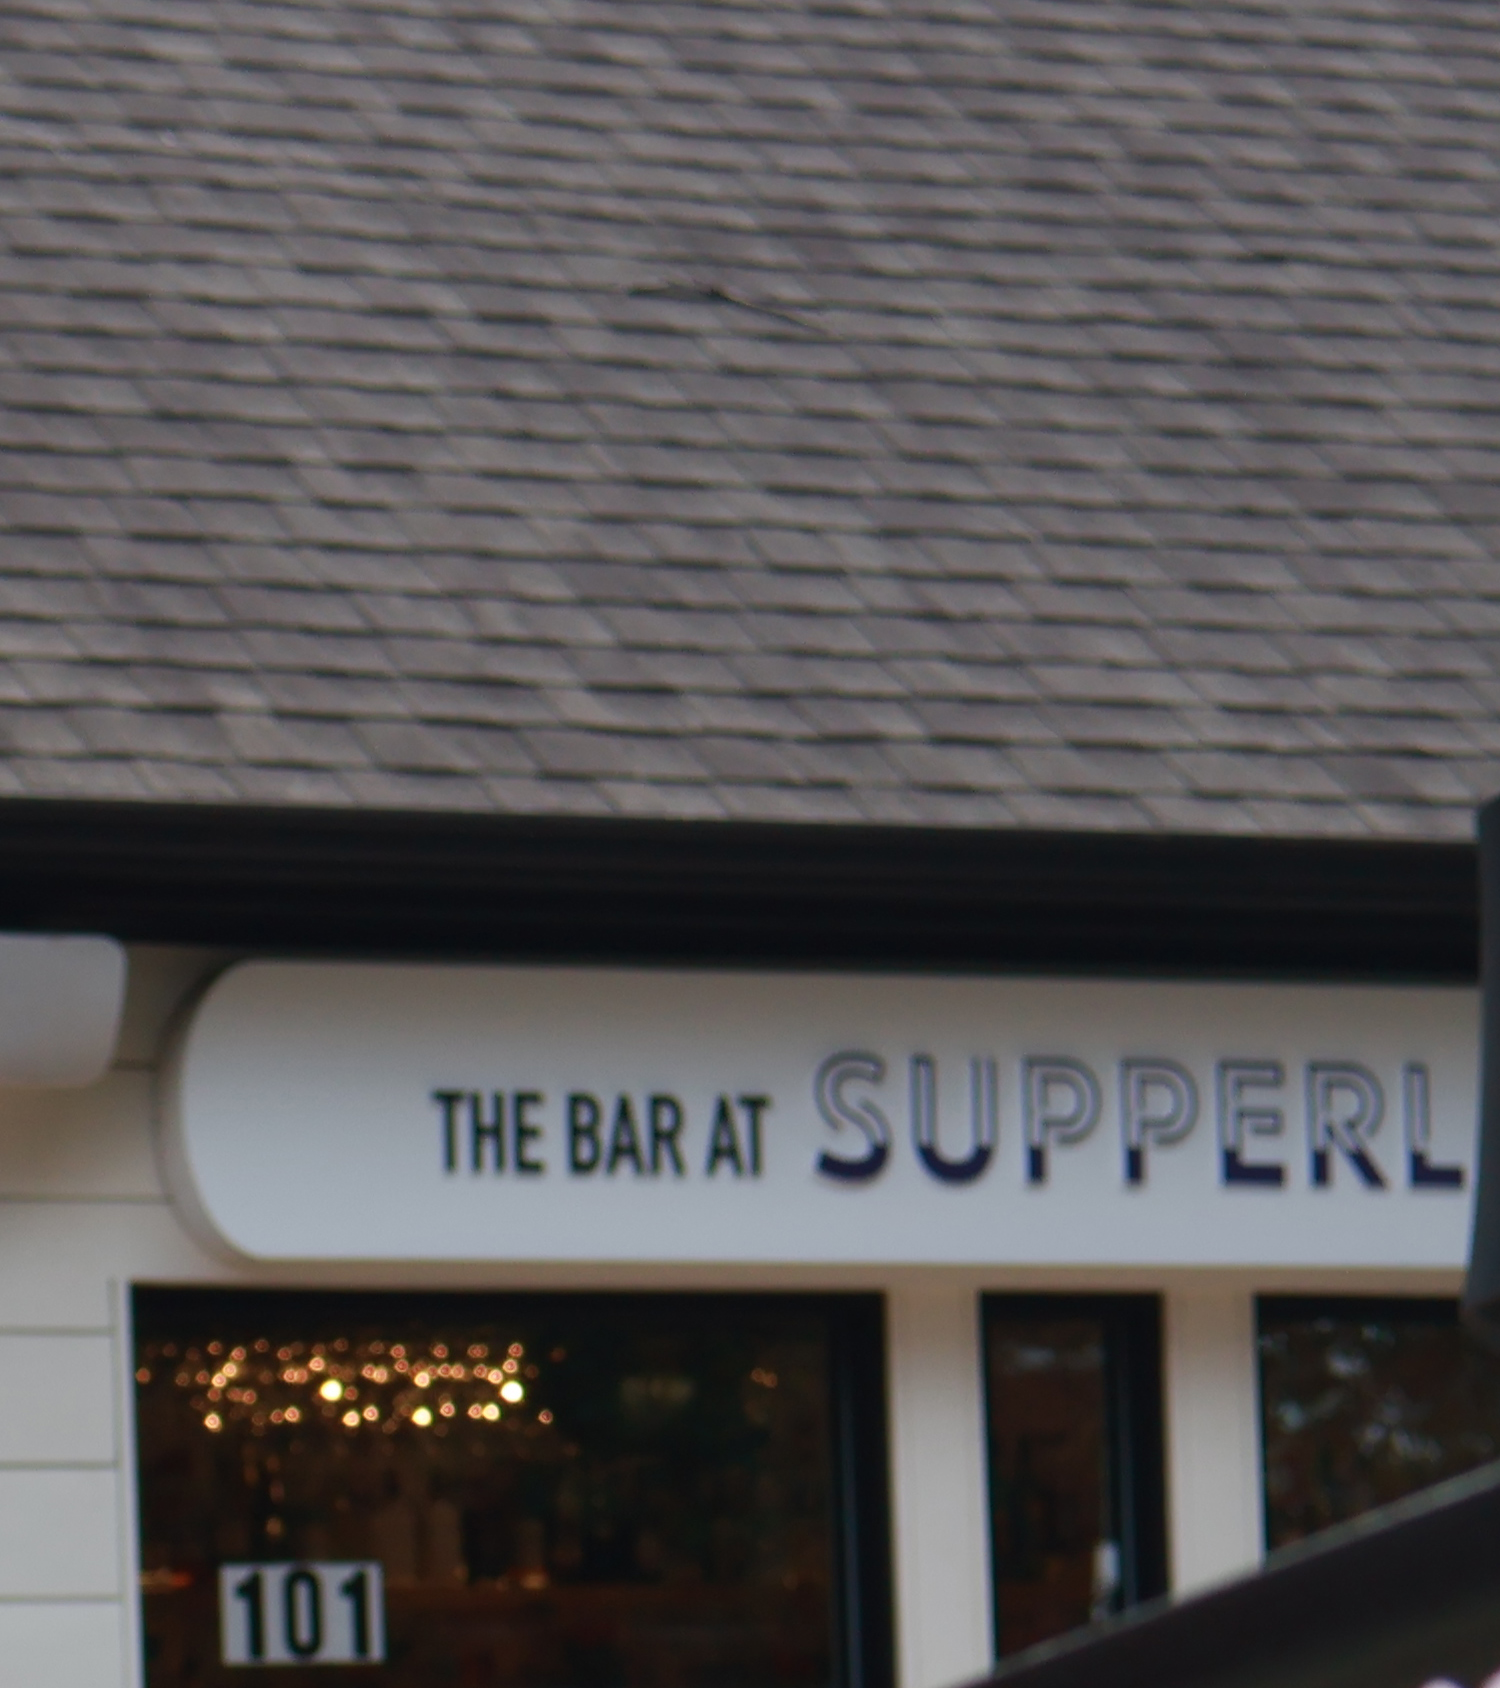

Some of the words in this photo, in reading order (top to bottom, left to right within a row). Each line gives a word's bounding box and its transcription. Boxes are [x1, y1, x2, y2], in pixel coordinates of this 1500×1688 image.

[431, 1089, 545, 1177] THE
[565, 1091, 686, 1178] BAR
[704, 1093, 771, 1178] AT
[814, 1051, 1465, 1188] SUPPERL
[234, 1570, 370, 1659] 101
